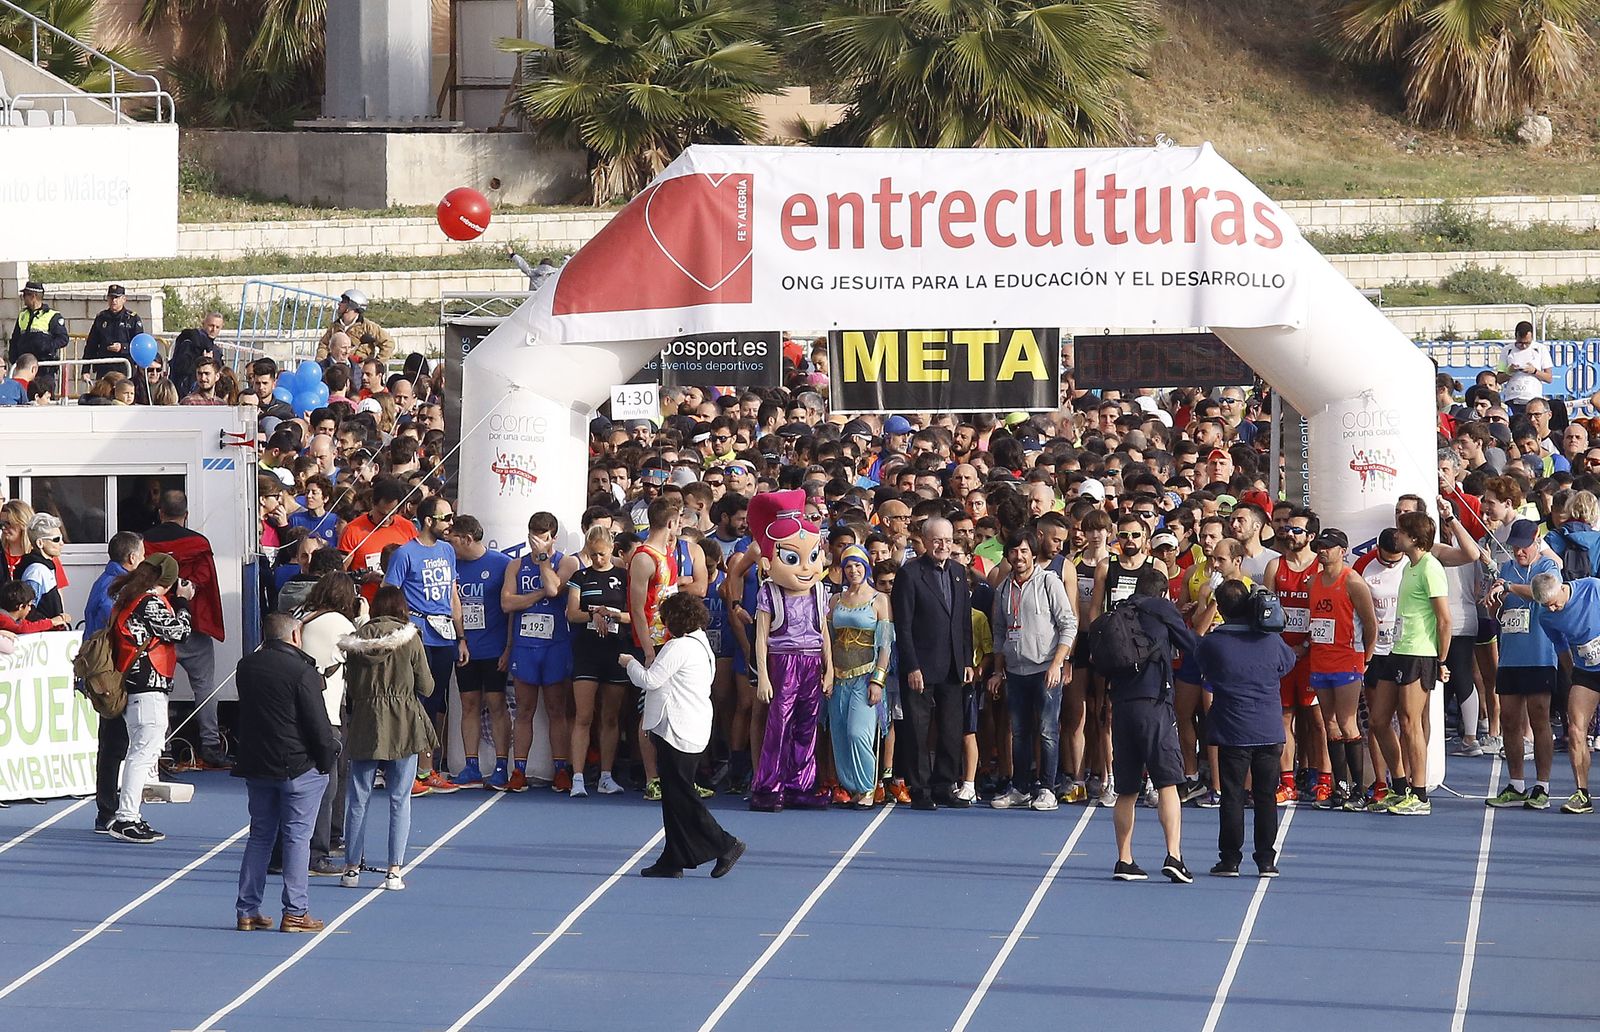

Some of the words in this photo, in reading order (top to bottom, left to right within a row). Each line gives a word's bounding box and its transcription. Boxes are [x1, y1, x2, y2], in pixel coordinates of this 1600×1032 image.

[0, 177, 30, 203] nto
[36, 175, 58, 202] de
[63, 172, 129, 206] Málaga
[736, 179, 748, 221] ALEGRÍA
[779, 167, 1285, 251] entreculturas
[737, 222, 747, 230] Y
[737, 230, 747, 242] FE
[781, 275, 824, 290] ONG
[830, 275, 905, 290] JESUITA
[912, 275, 959, 289] PARA
[965, 274, 988, 289] LA
[993, 267, 1107, 289] EDUCACIÓN
[1114, 271, 1126, 286] Y
[1132, 271, 1155, 286] EL
[1161, 270, 1286, 289] DESARROLLO
[841, 329, 1050, 383] META
[660, 361, 703, 371] eventos
[705, 360, 764, 372] deportivos
[616, 390, 654, 406] 4:30
[622, 407, 649, 416] min/km
[1342, 408, 1401, 430] corre
[489, 413, 548, 435] corre
[488, 432, 502, 441] por
[503, 433, 519, 441] una
[520, 434, 545, 443] causa
[1342, 430, 1357, 440] por
[1358, 429, 1374, 438] una
[521, 575, 544, 590] RC
[529, 622, 544, 632] 193
[1313, 628, 1326, 637] 282
